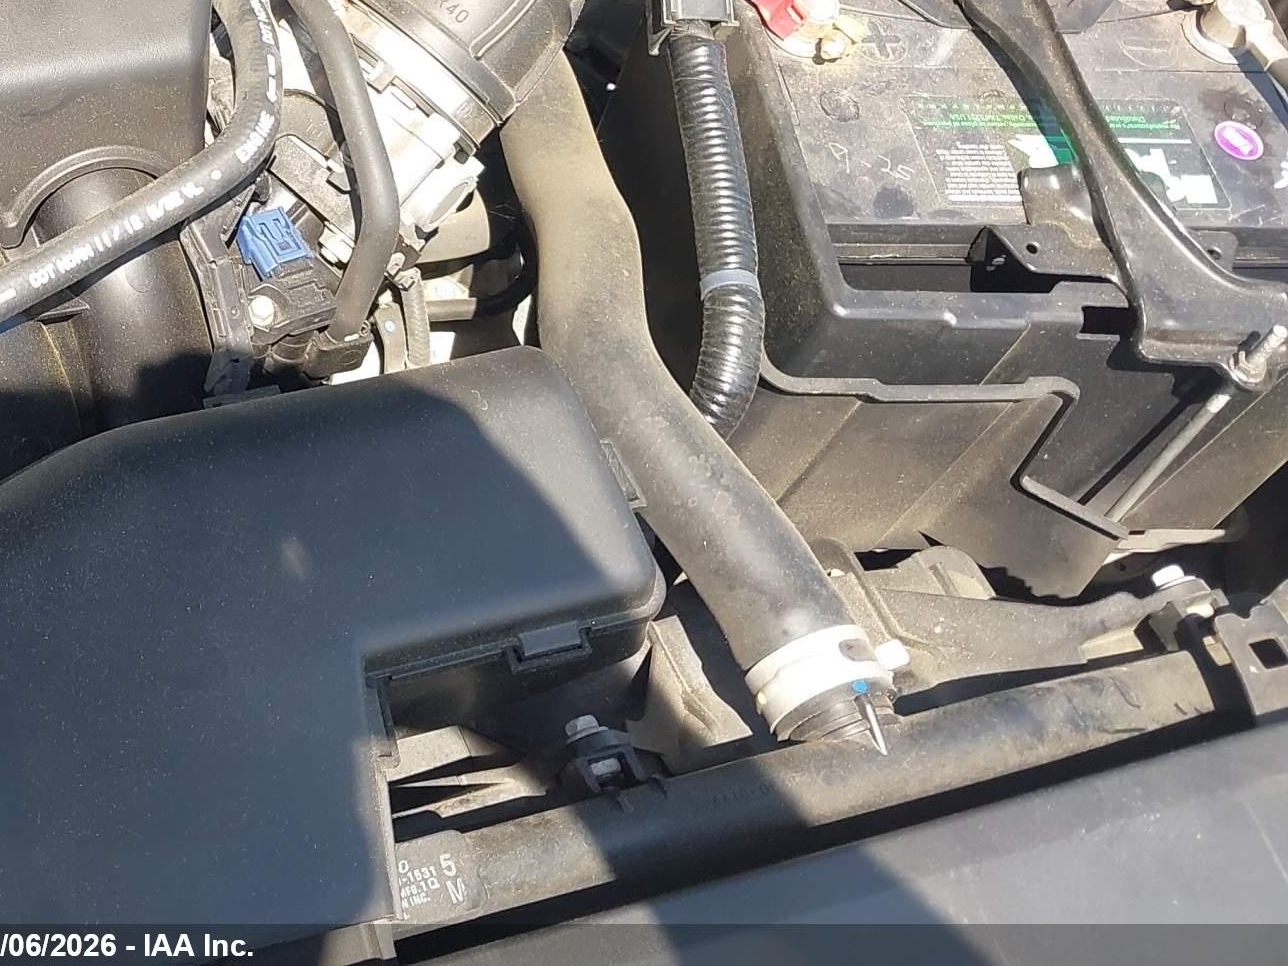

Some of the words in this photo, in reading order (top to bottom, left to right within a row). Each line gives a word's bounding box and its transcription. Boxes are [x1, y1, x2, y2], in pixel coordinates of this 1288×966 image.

[28, 263, 57, 289] DOT
[439, 853, 457, 877] 5
[445, 877, 468, 904] M
